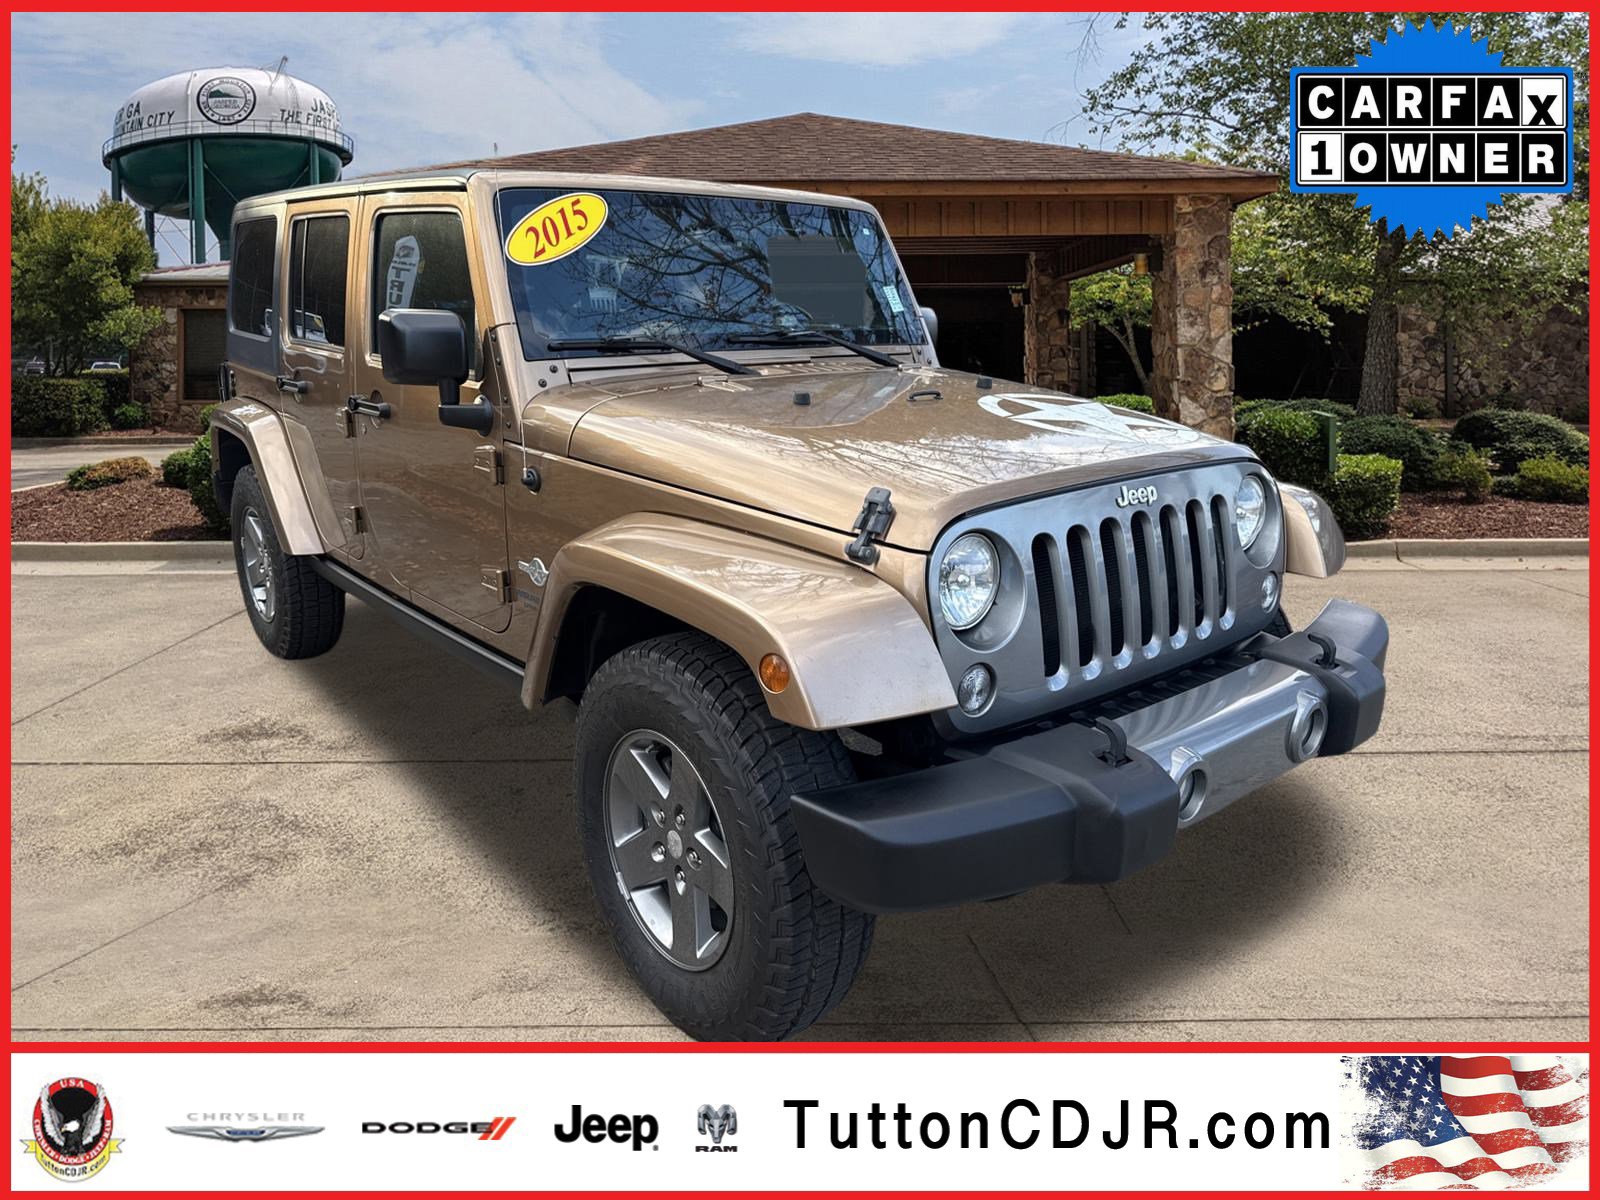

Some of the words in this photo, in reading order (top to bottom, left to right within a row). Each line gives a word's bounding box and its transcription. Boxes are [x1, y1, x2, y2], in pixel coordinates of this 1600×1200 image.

[127, 100, 141, 119] GA
[147, 110, 175, 127] CITY
[280, 109, 302, 123] THE
[307, 112, 331, 129] FIRST
[525, 198, 589, 259] 2015
[1115, 485, 1158, 508] Jeep
